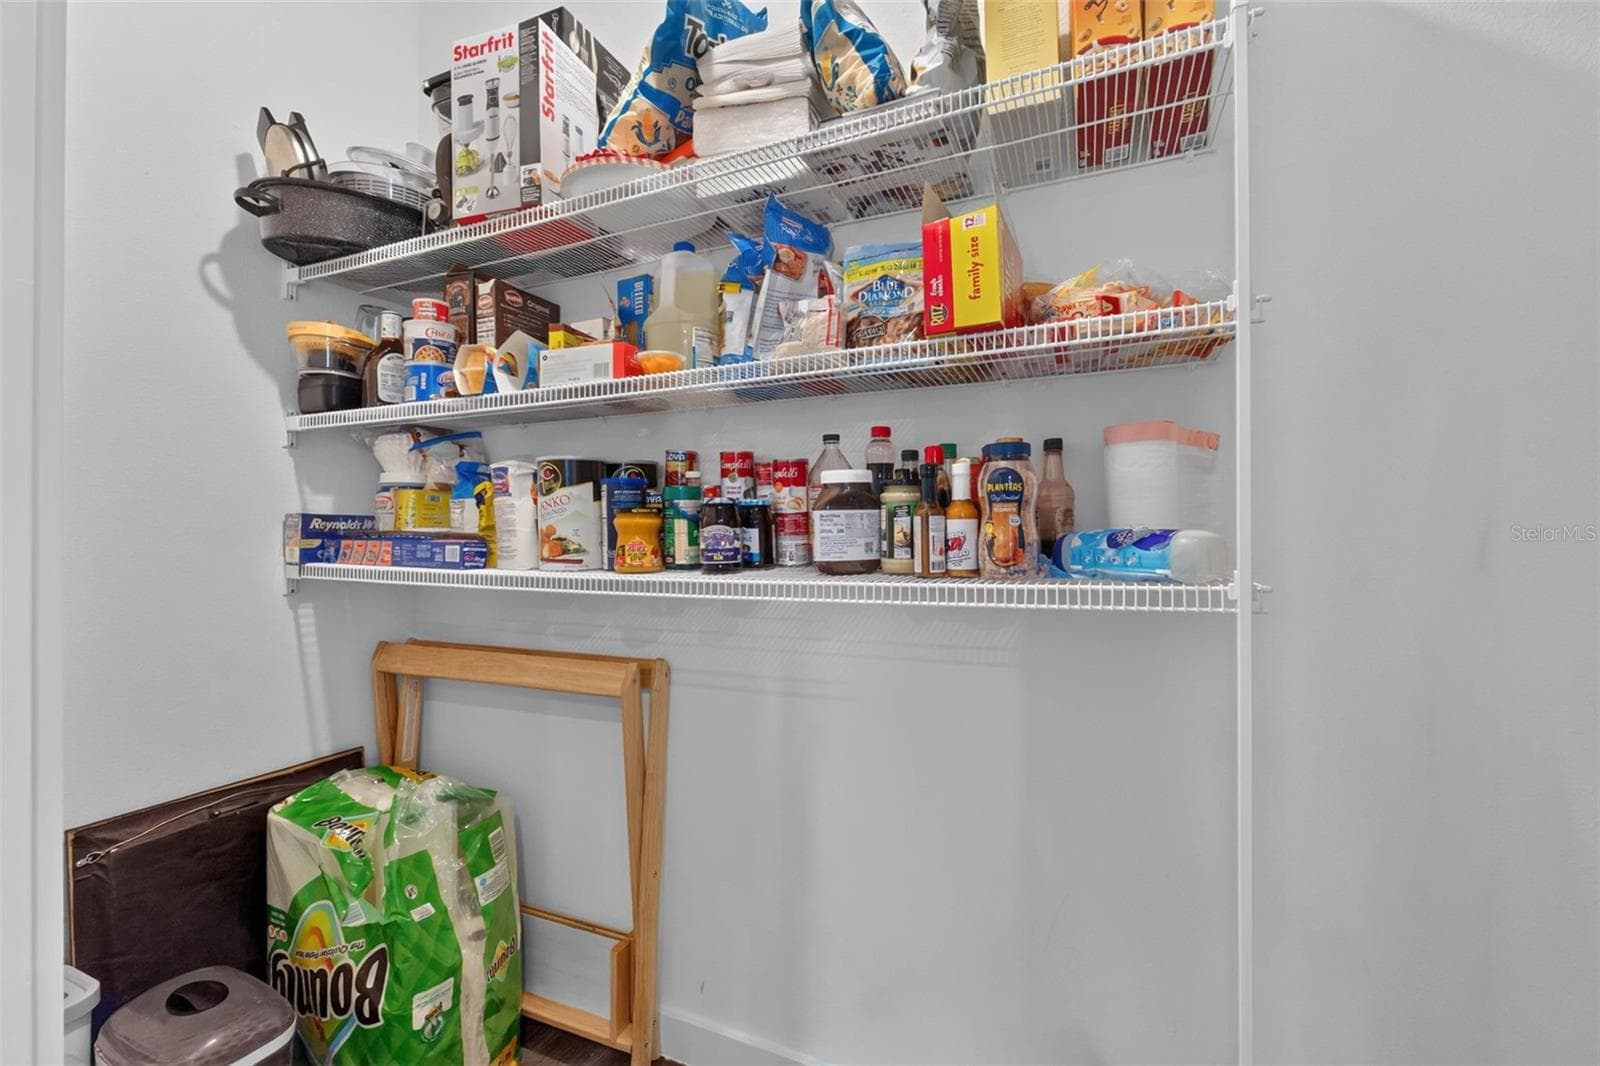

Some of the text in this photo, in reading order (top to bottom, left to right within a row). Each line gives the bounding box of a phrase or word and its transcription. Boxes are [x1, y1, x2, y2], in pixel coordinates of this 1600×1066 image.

[453, 31, 514, 62] Starfrit
[541, 31, 556, 122] Starfrit
[964, 216, 975, 228] 12
[967, 235, 985, 301] family size
[873, 279, 899, 291] BLUE
[858, 287, 914, 302] DIAMOND
[930, 304, 944, 326] RITZ
[987, 483, 1022, 492] PLANTERS
[309, 517, 363, 532] Reynolds
[271, 946, 388, 1026] Bounty
